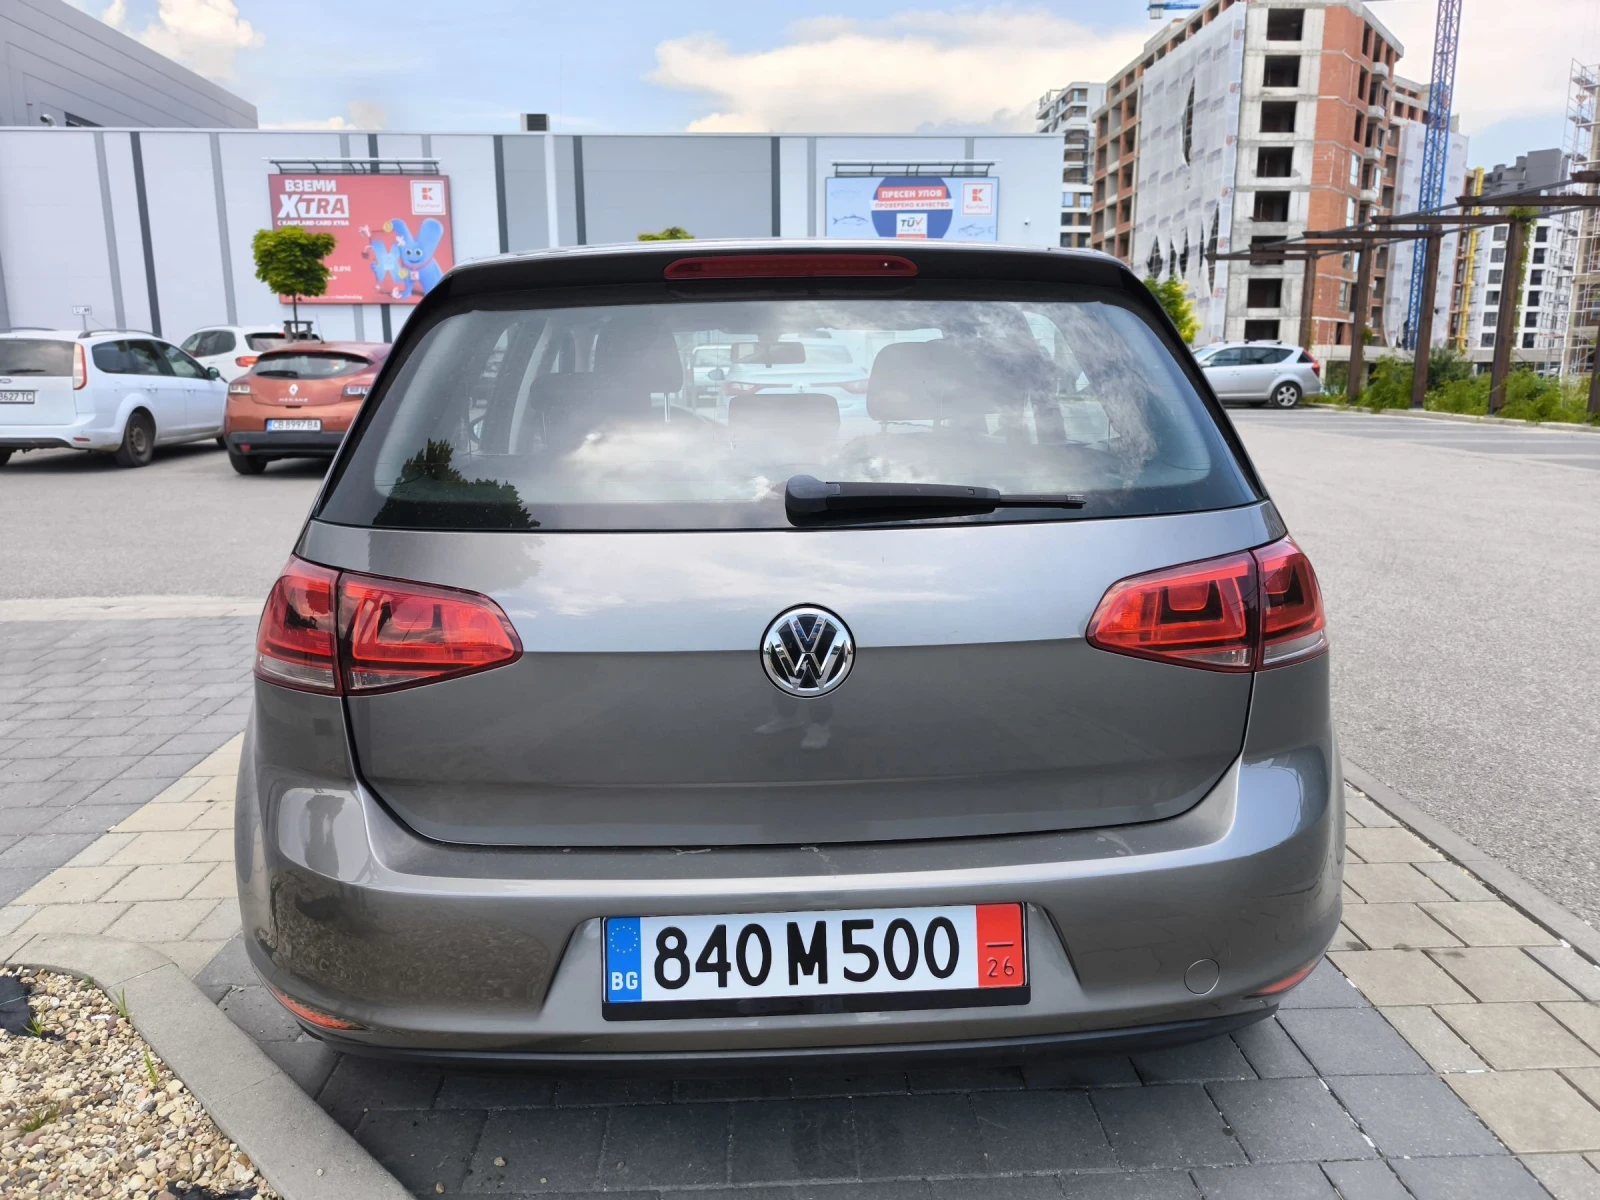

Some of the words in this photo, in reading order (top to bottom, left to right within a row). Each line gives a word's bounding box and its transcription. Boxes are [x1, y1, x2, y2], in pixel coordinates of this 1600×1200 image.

[284, 179, 337, 192] ВЗЕМИ
[881, 190, 915, 199] ПРЕСЕН
[277, 194, 349, 219] XTRA
[21, 392, 33, 401] TC
[273, 420, 283, 429] CB
[285, 420, 305, 429] 8997
[307, 420, 318, 428] BA
[653, 923, 773, 990] 840
[786, 920, 829, 986] M
[841, 916, 960, 983] 500
[986, 956, 1015, 978] 26
[611, 971, 639, 991] BG
